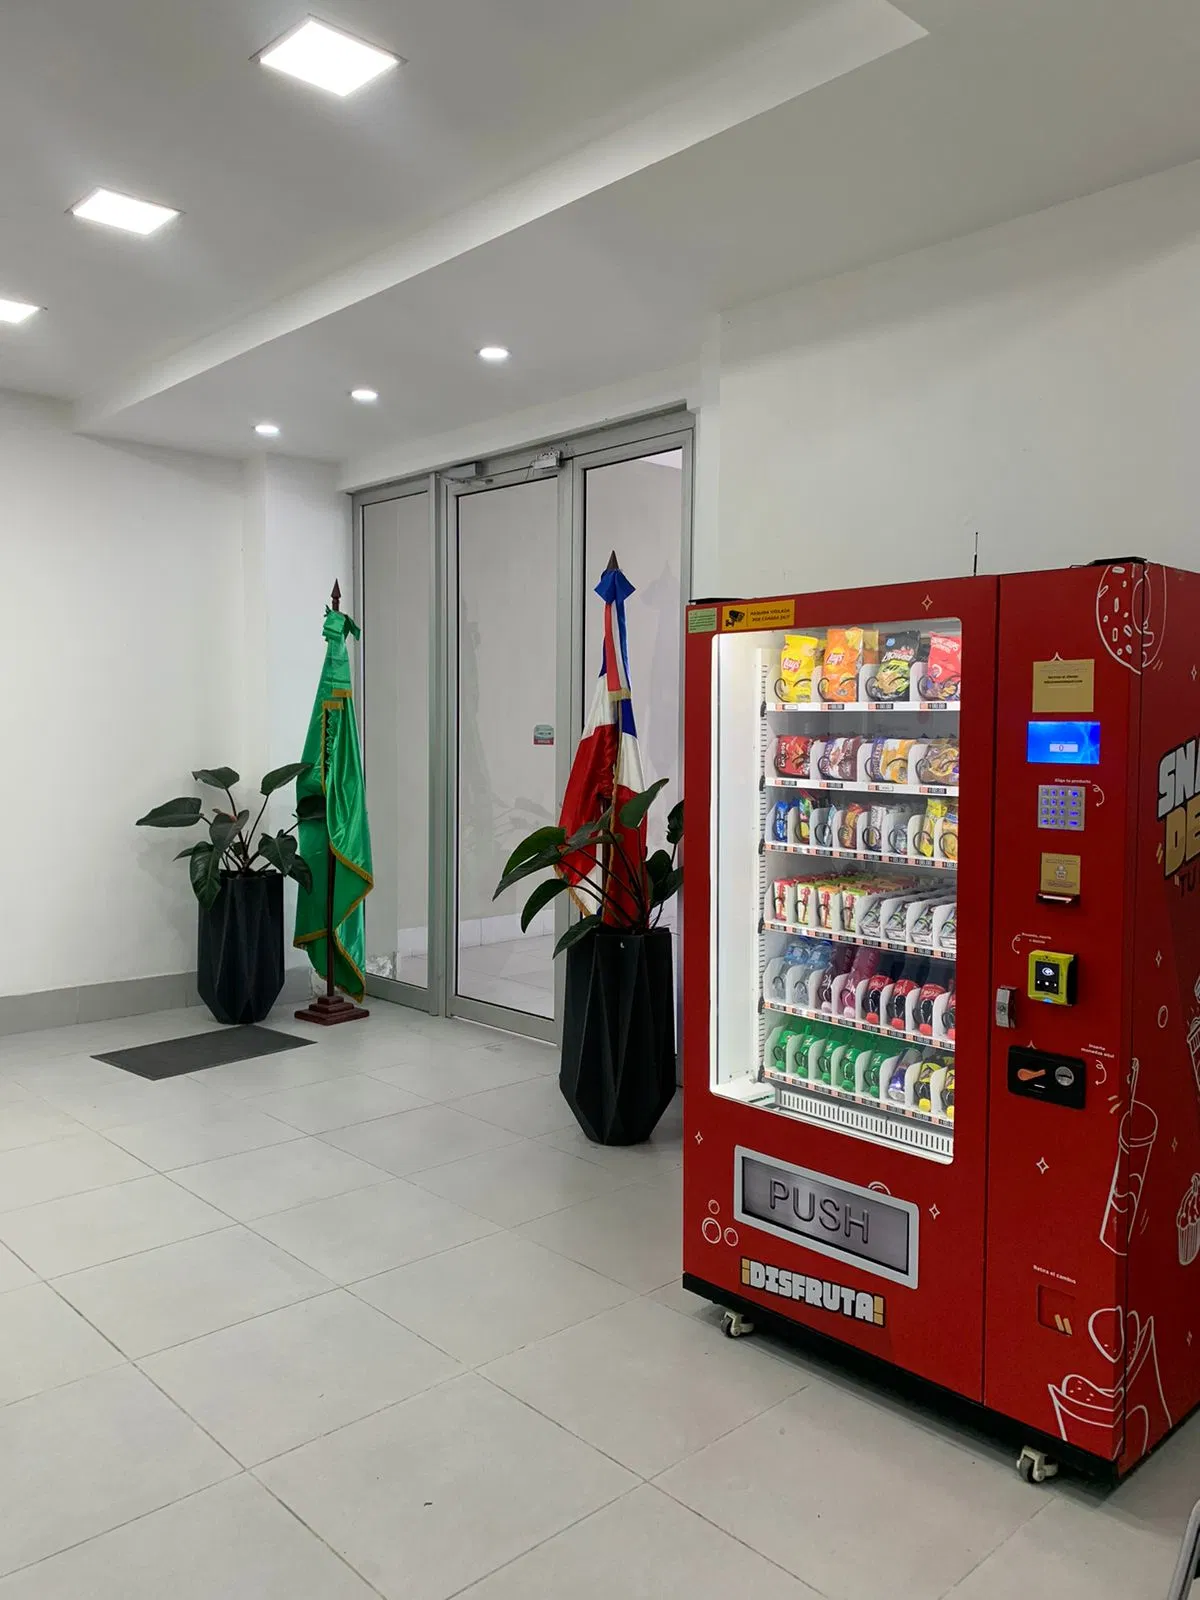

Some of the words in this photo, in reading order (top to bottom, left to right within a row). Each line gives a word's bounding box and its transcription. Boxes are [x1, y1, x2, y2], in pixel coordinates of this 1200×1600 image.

[1157, 735, 1200, 819] SN
[770, 1178, 869, 1244] PUSH
[740, 1257, 885, 1327] ¡DISFRUTA!
